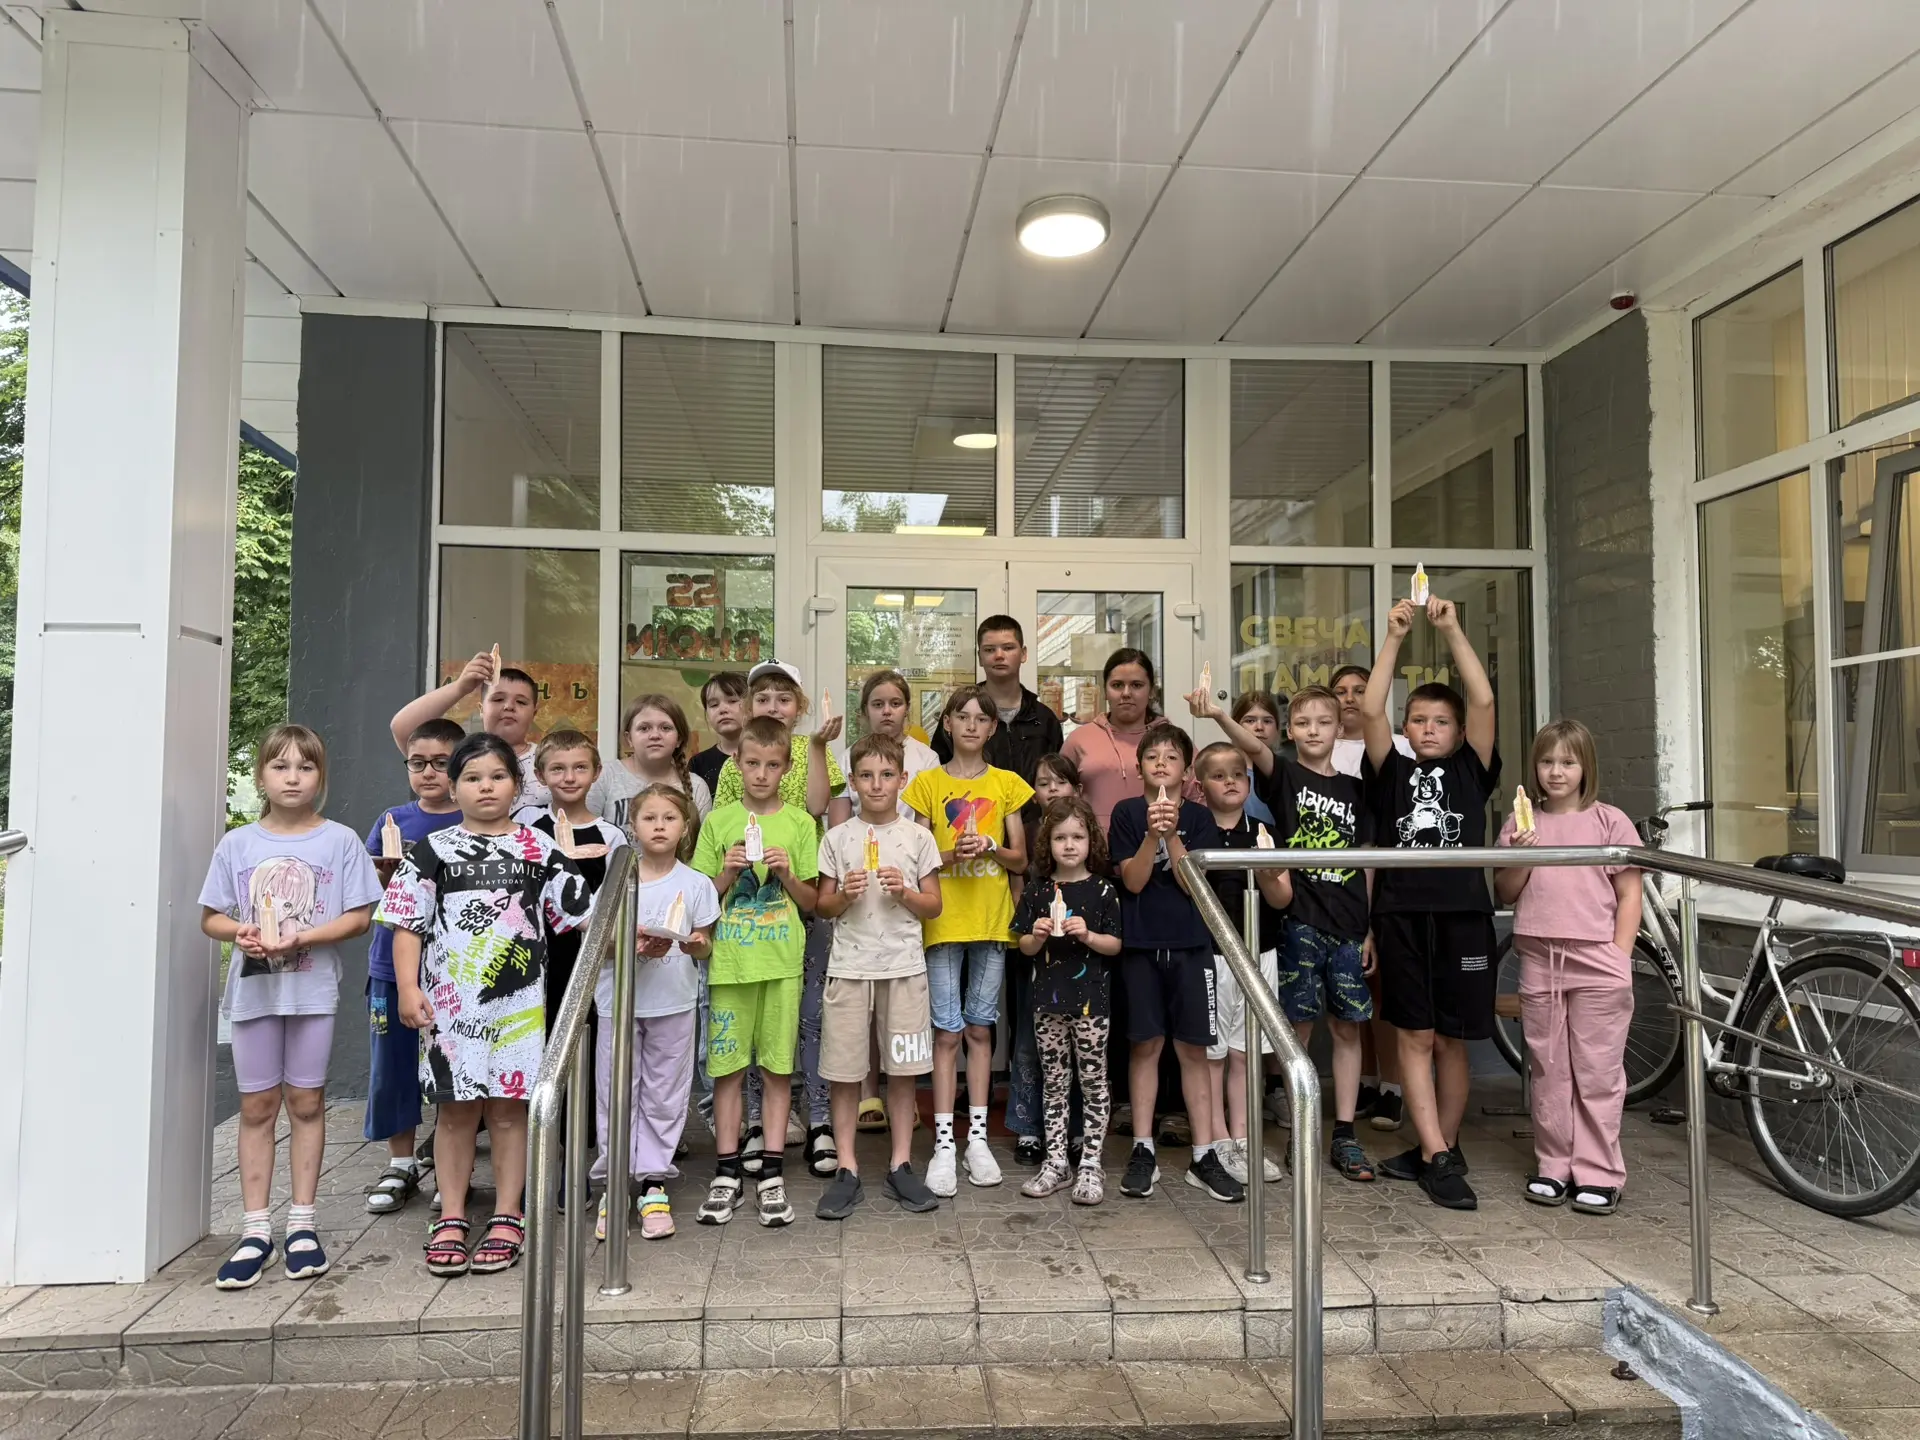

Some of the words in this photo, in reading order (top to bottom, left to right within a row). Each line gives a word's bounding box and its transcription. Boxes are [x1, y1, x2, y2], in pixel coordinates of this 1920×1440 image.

[666, 573, 721, 607] 22
[627, 623, 760, 662] ИЮНЯ
[1240, 615, 1370, 649] СВЕЧА
[443, 863, 489, 881] JUST
[498, 862, 545, 881] SMILE
[460, 908, 493, 928] GOOD
[466, 898, 501, 920] VIBES
[481, 934, 514, 988] HAPPIER
[511, 944, 532, 976] THE
[1203, 967, 1216, 1010] ATHLETIC
[1208, 1009, 1217, 1036] HERO
